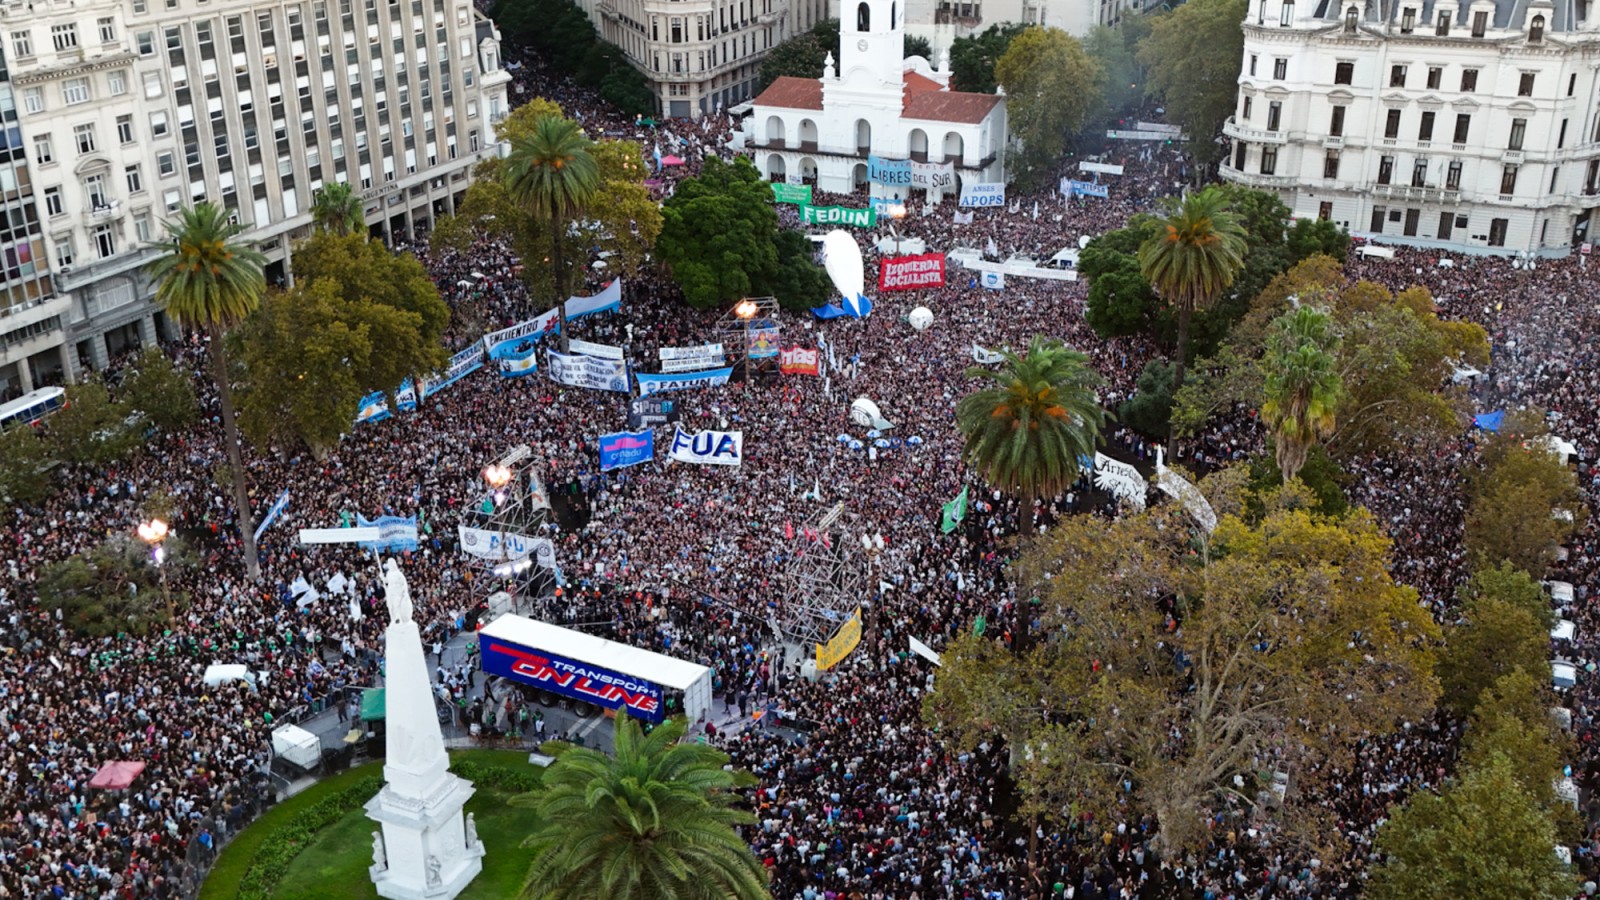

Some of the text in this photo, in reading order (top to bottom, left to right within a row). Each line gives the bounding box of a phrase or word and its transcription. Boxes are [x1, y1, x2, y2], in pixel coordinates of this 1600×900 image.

[871, 165, 952, 188] LIBRES DEL SUR
[362, 182, 399, 200] ARGENTINA
[973, 184, 996, 193] ANSES
[961, 194, 1003, 206] APOPS
[804, 206, 870, 226] FEDUN
[885, 259, 941, 276] IZQUIERDA
[883, 271, 942, 288] SOCIALISTA
[489, 319, 539, 346] ENCUENTRO
[659, 377, 712, 389] FATUN
[672, 430, 738, 458] FUA
